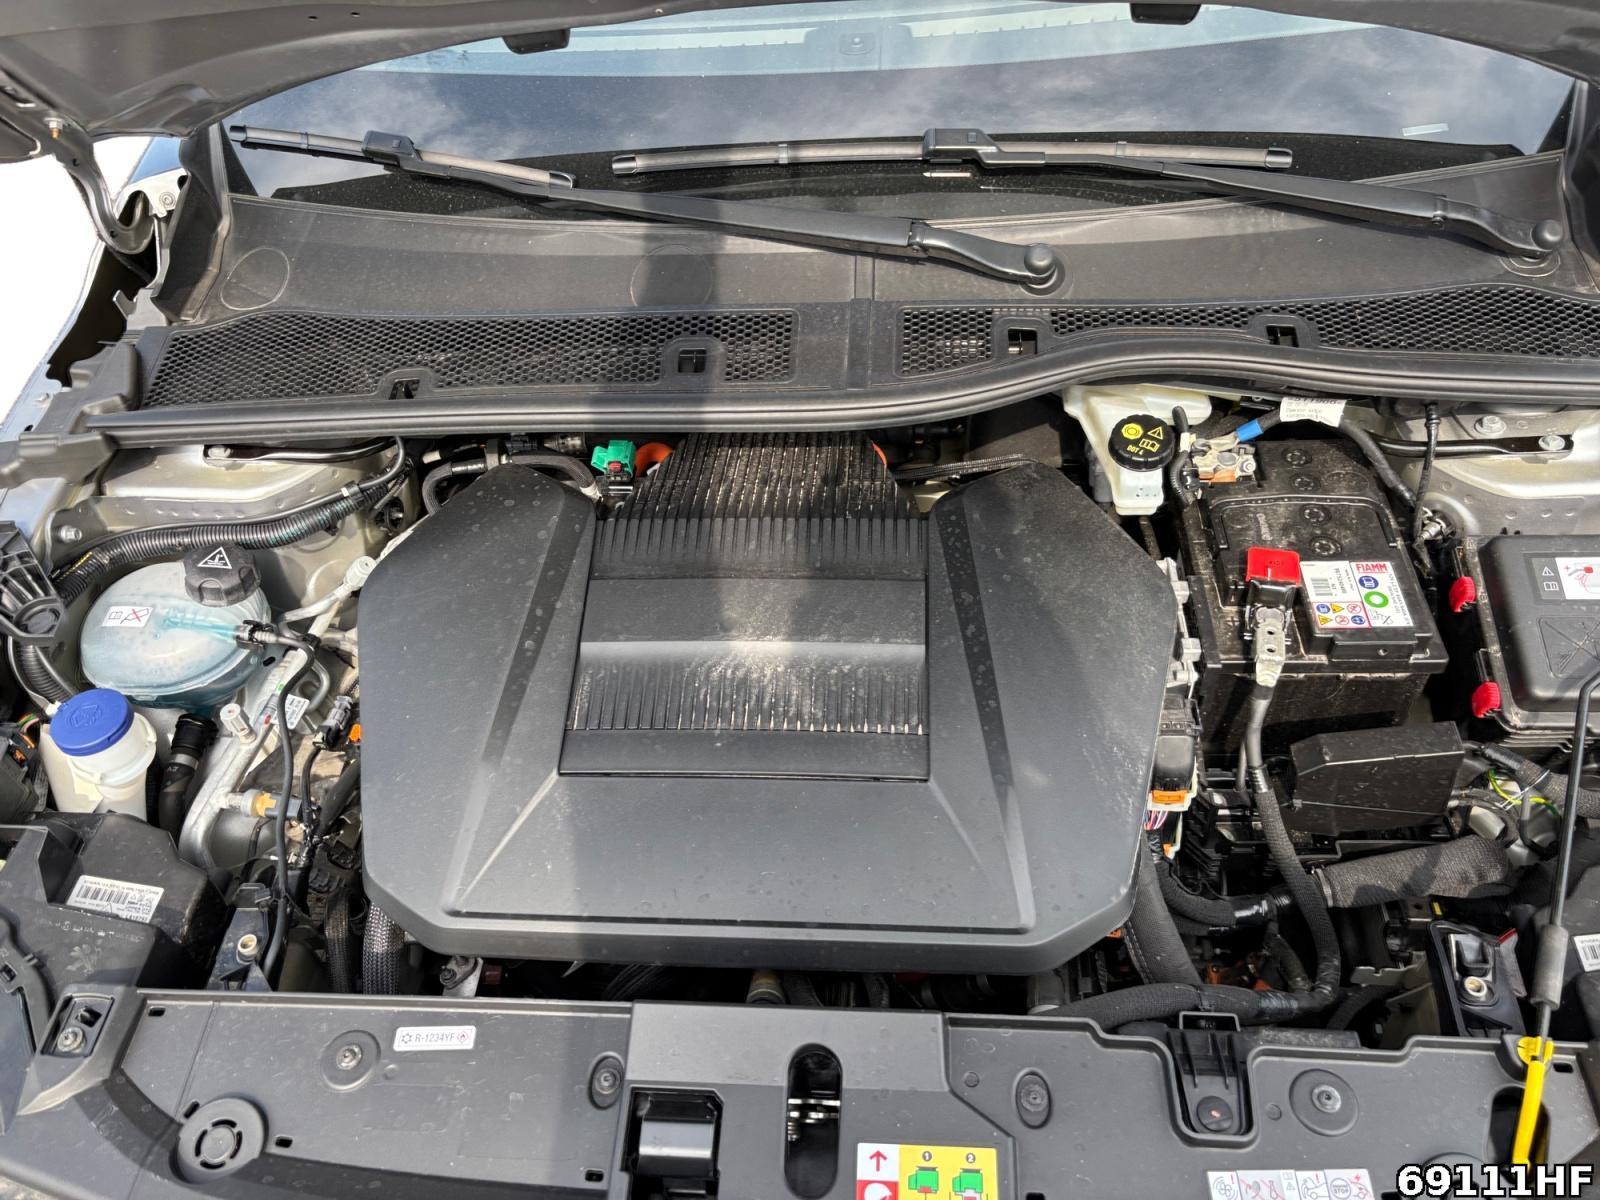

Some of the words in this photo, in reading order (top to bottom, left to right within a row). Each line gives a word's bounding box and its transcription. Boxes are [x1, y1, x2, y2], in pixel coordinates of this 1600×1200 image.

[1127, 444, 1139, 454] DOT
[1355, 563, 1388, 573] FIAMM
[415, 1031, 455, 1043] R-1234YF
